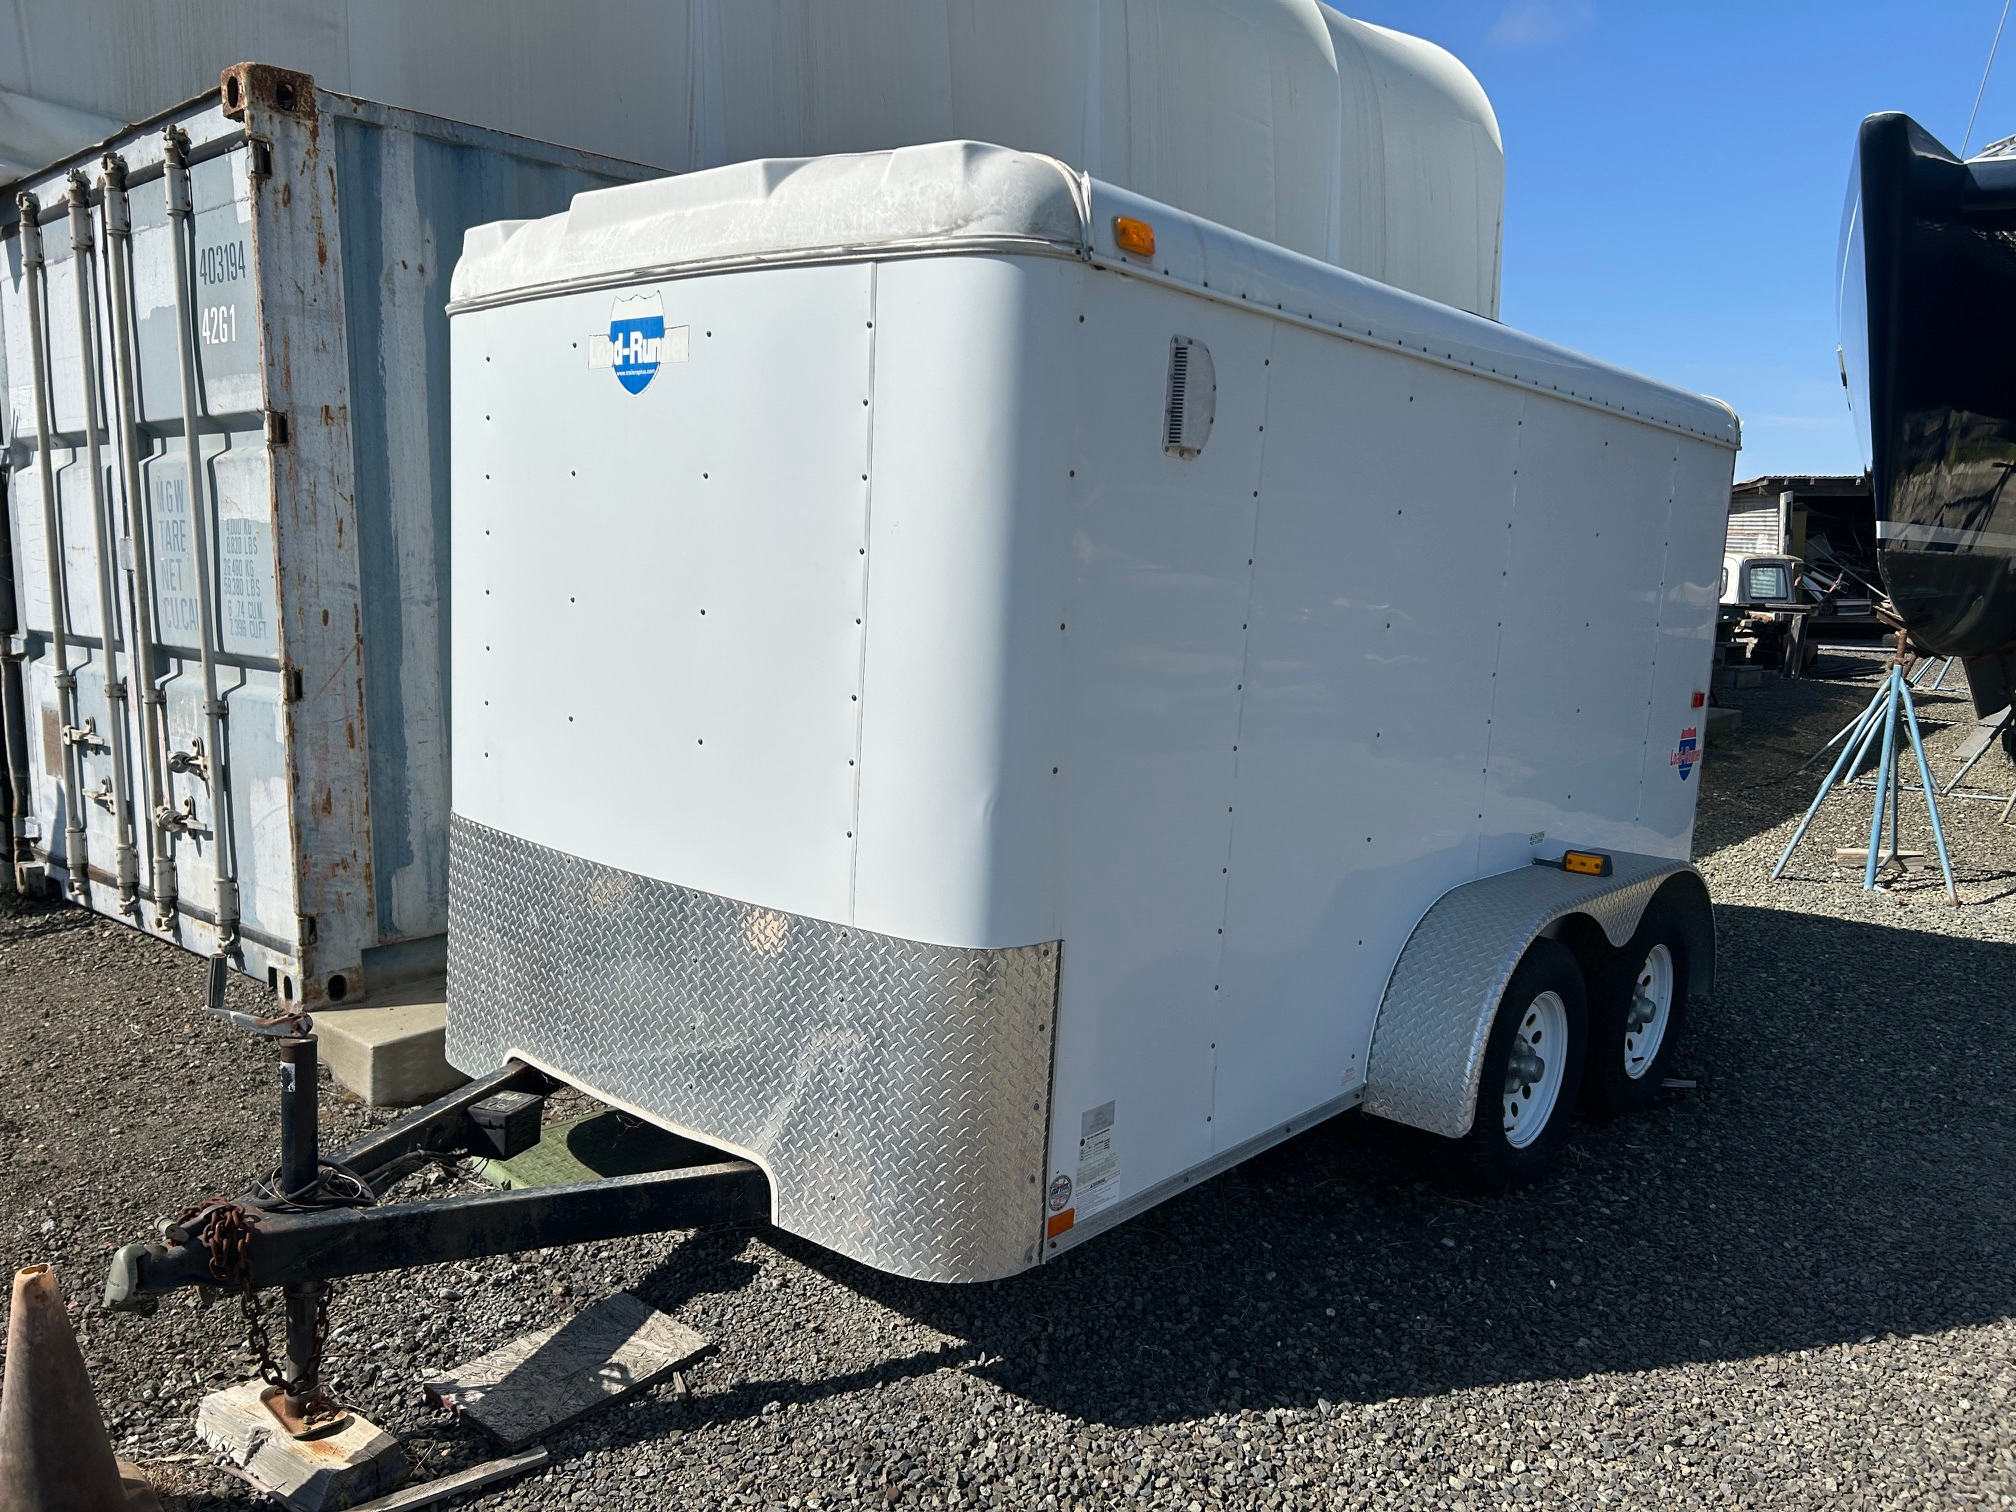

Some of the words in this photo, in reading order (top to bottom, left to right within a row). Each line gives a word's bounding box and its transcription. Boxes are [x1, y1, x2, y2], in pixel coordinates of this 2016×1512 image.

[200, 240, 246, 286] 403194
[202, 304, 237, 345] 42G1
[155, 479, 184, 513] MGW
[159, 520, 186, 553] TARE
[244, 536, 258, 555] LBS
[161, 559, 183, 592] NET
[245, 559, 255, 577] KG
[246, 578, 261, 597] LBS
